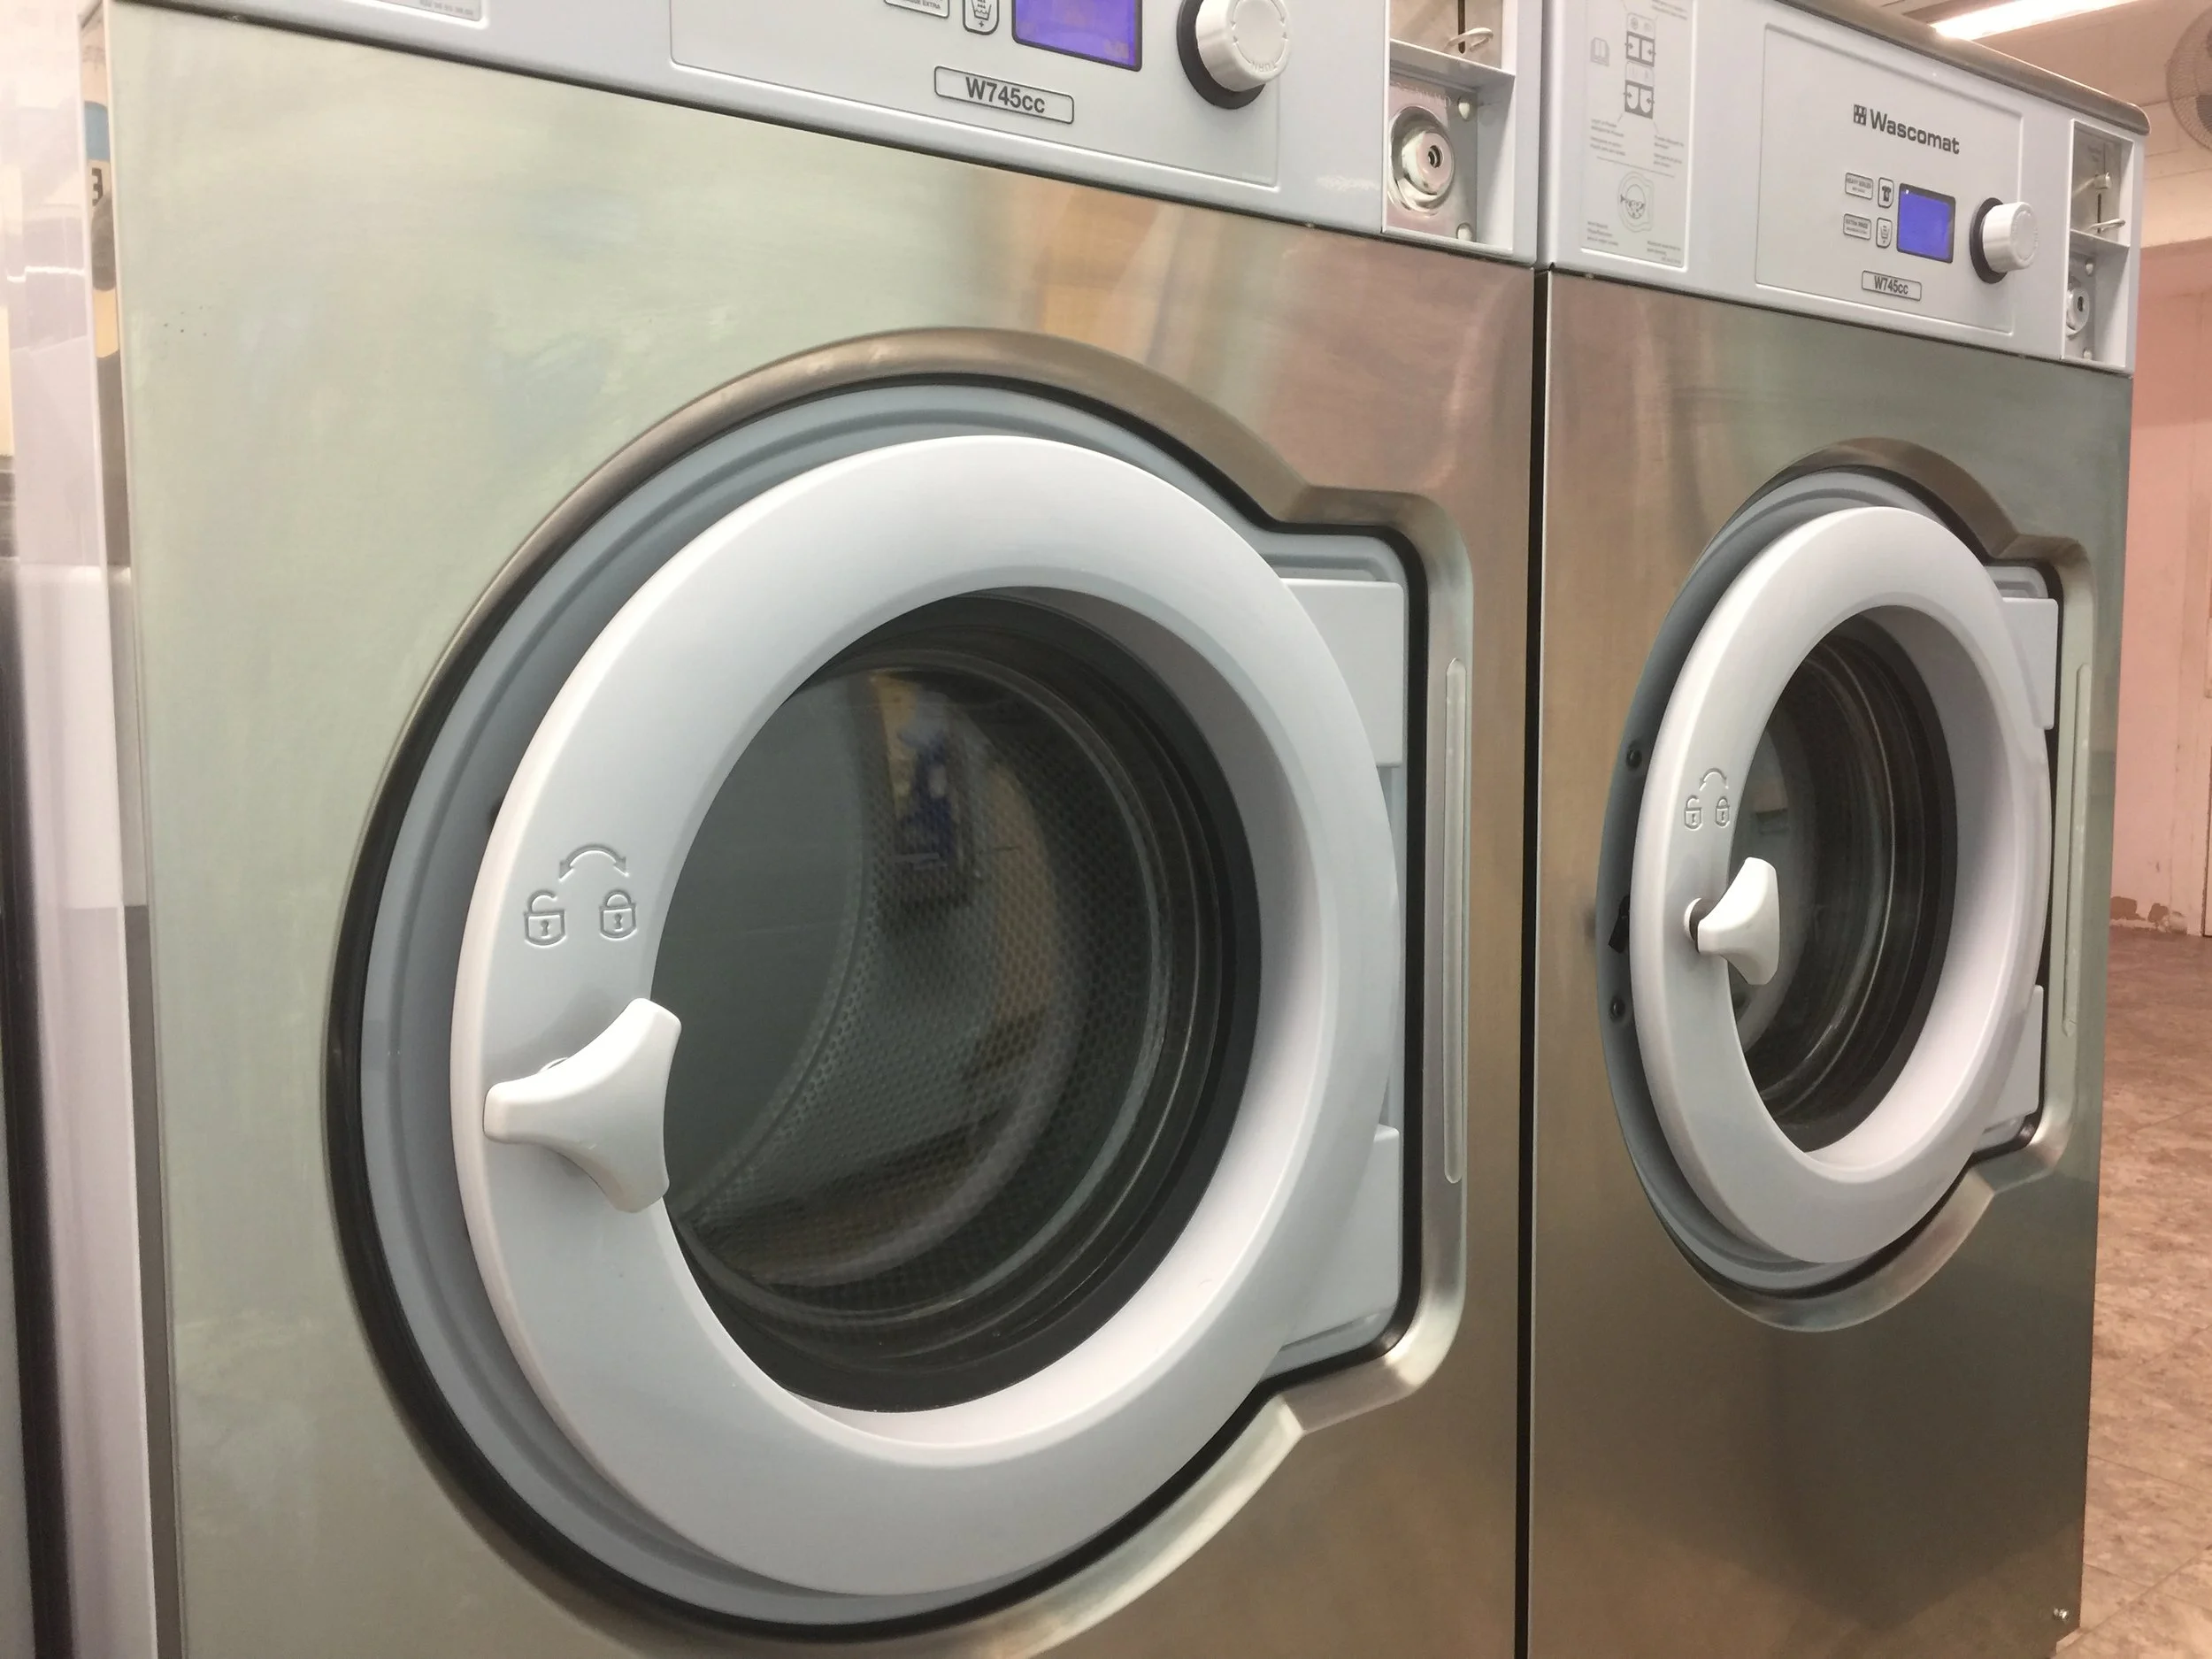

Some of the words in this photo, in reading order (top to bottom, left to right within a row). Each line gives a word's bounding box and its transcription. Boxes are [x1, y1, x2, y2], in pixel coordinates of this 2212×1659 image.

[965, 76, 1045, 113] W745cc
[1870, 108, 1960, 155] Wascomat
[1874, 275, 1909, 295] W745cc
